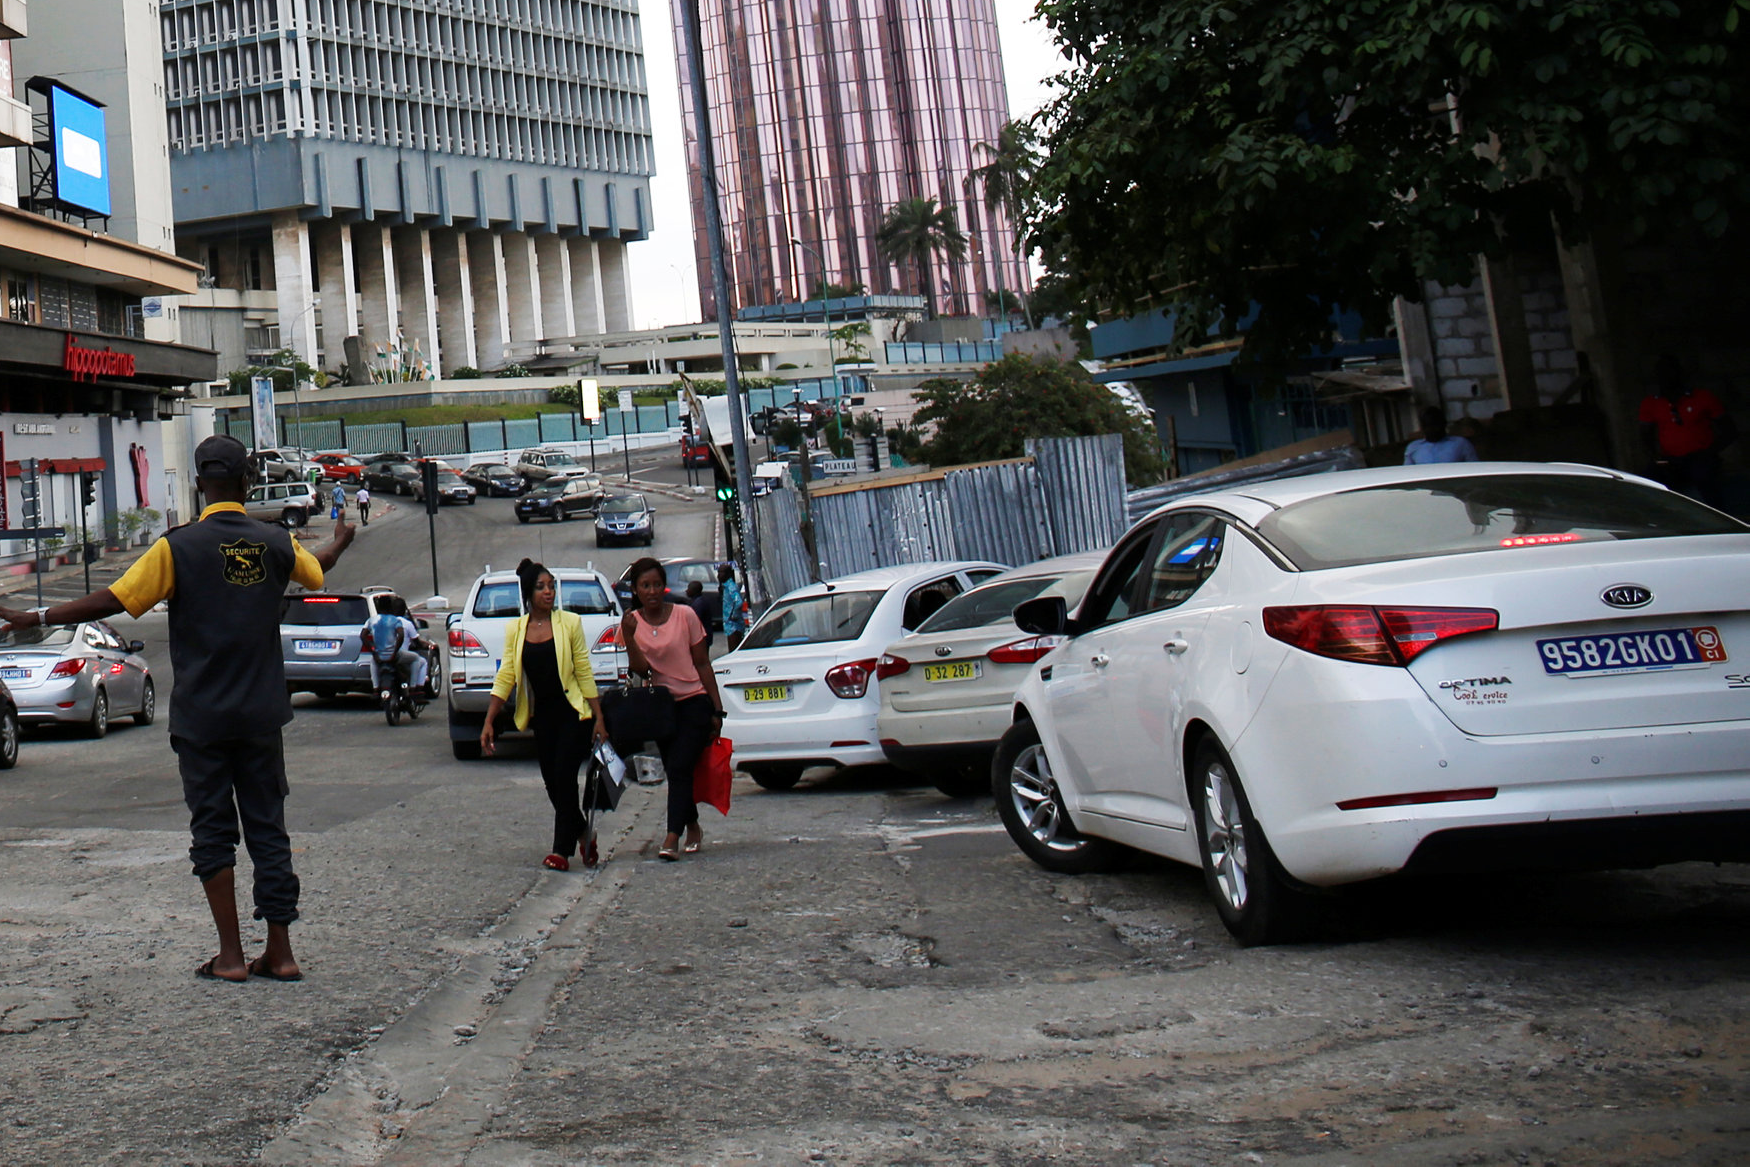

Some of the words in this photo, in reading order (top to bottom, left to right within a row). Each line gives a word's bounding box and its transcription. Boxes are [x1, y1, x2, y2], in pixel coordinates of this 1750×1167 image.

[64, 334, 136, 384] hippopotamus
[825, 462, 856, 471] PLATEAU
[1609, 589, 1644, 603] KIA
[1542, 632, 1694, 670] 9582GK01
